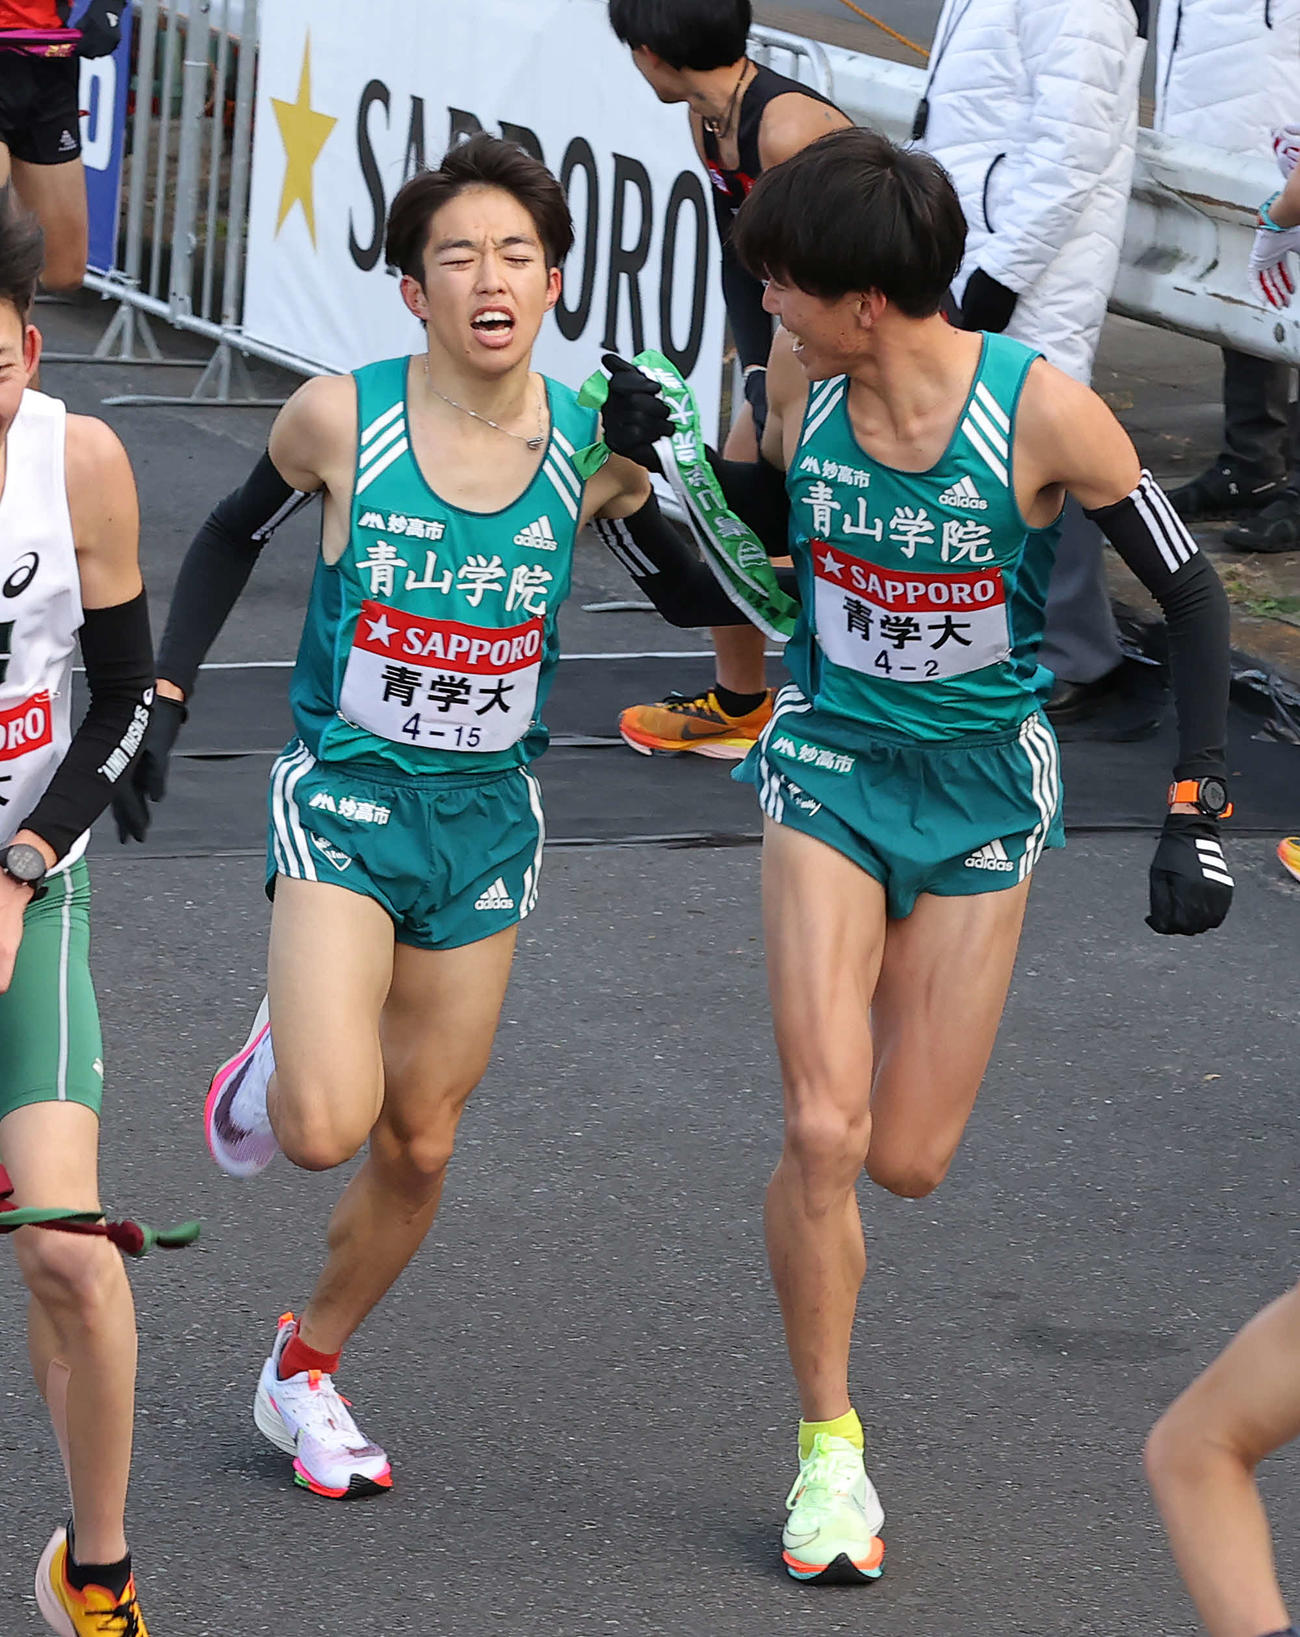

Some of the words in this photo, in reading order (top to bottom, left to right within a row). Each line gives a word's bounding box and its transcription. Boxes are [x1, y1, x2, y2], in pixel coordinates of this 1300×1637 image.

[348, 78, 709, 381] SAORO
[822, 459, 871, 488] 妙高市
[938, 494, 988, 510] adidas
[387, 513, 445, 541] 妙高市
[801, 480, 995, 563] 青山学院
[513, 534, 558, 551] adidas
[355, 540, 553, 615] 青山学院
[850, 565, 995, 605] SAPPORO
[842, 596, 973, 650] 青学大
[402, 627, 541, 666] SAPPORO
[874, 650, 939, 677] 4-2
[381, 664, 515, 716] 青学大
[402, 712, 482, 747] 4-15
[799, 743, 856, 774] 妙高市
[337, 797, 391, 826] 妙高市
[964, 857, 1015, 872] adidas
[474, 898, 514, 911] adidas
